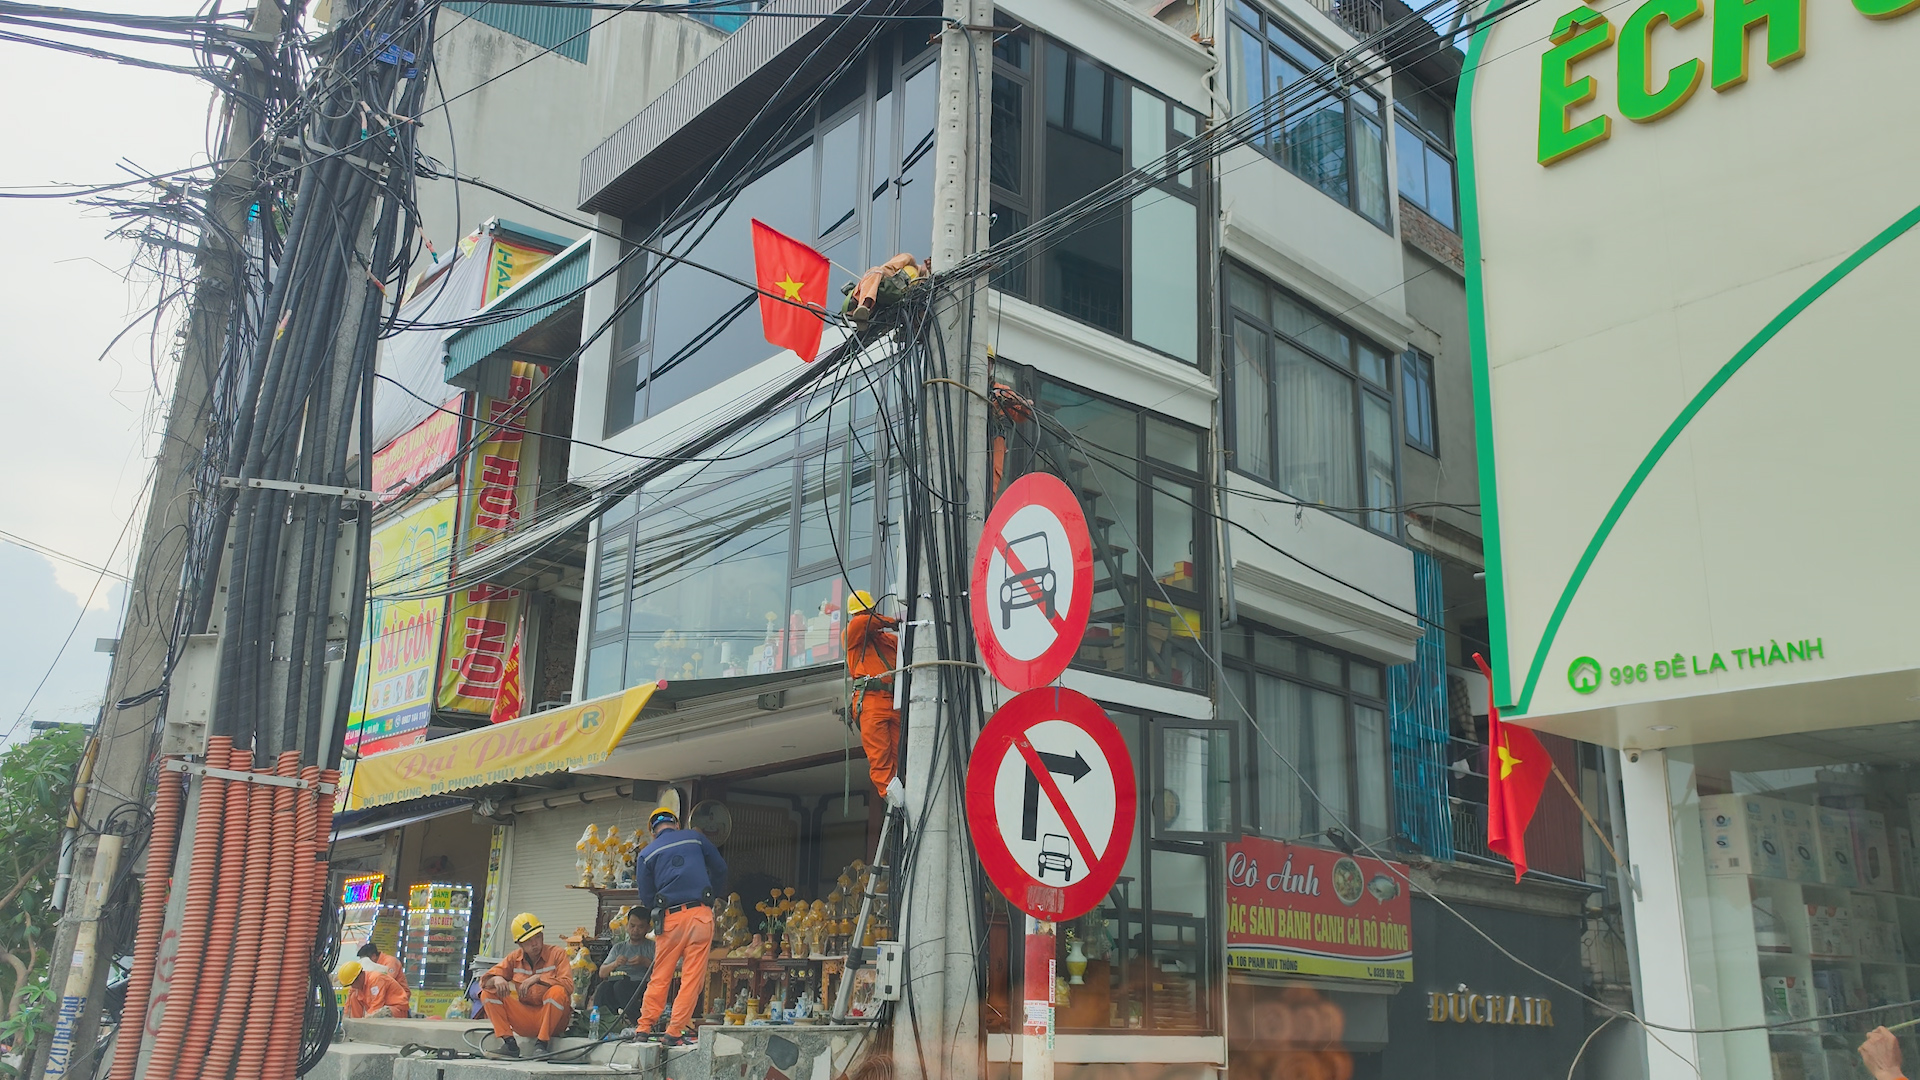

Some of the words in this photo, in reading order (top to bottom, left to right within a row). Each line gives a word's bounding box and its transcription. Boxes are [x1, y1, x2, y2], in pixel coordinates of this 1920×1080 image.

[476, 454, 522, 533] HƠI
[377, 609, 403, 676] SÀI
[404, 599, 437, 666] GÒN
[1609, 665, 1648, 686] 996
[1654, 653, 1687, 680] ĐÊ
[1692, 653, 1728, 676] LA
[1731, 637, 1824, 670] THÀNH
[396, 743, 458, 780] Đại
[469, 719, 568, 770] Phát
[397, 784, 422, 798] CÚNG
[431, 777, 445, 793] ĐỒ
[448, 772, 483, 789] PHONG
[487, 764, 517, 783] THỦY
[1228, 851, 1260, 888] Cô
[1266, 852, 1321, 897] Ánh
[1250, 898, 1275, 937] SẢN
[1278, 904, 1312, 941] BÁNH
[1314, 913, 1345, 944] CANH
[1347, 913, 1361, 946] CÁ
[1363, 915, 1378, 948] RÔ
[1380, 912, 1409, 951] ĐỒNG
[1236, 956, 1247, 967] 106
[1267, 958, 1278, 969] HUY
